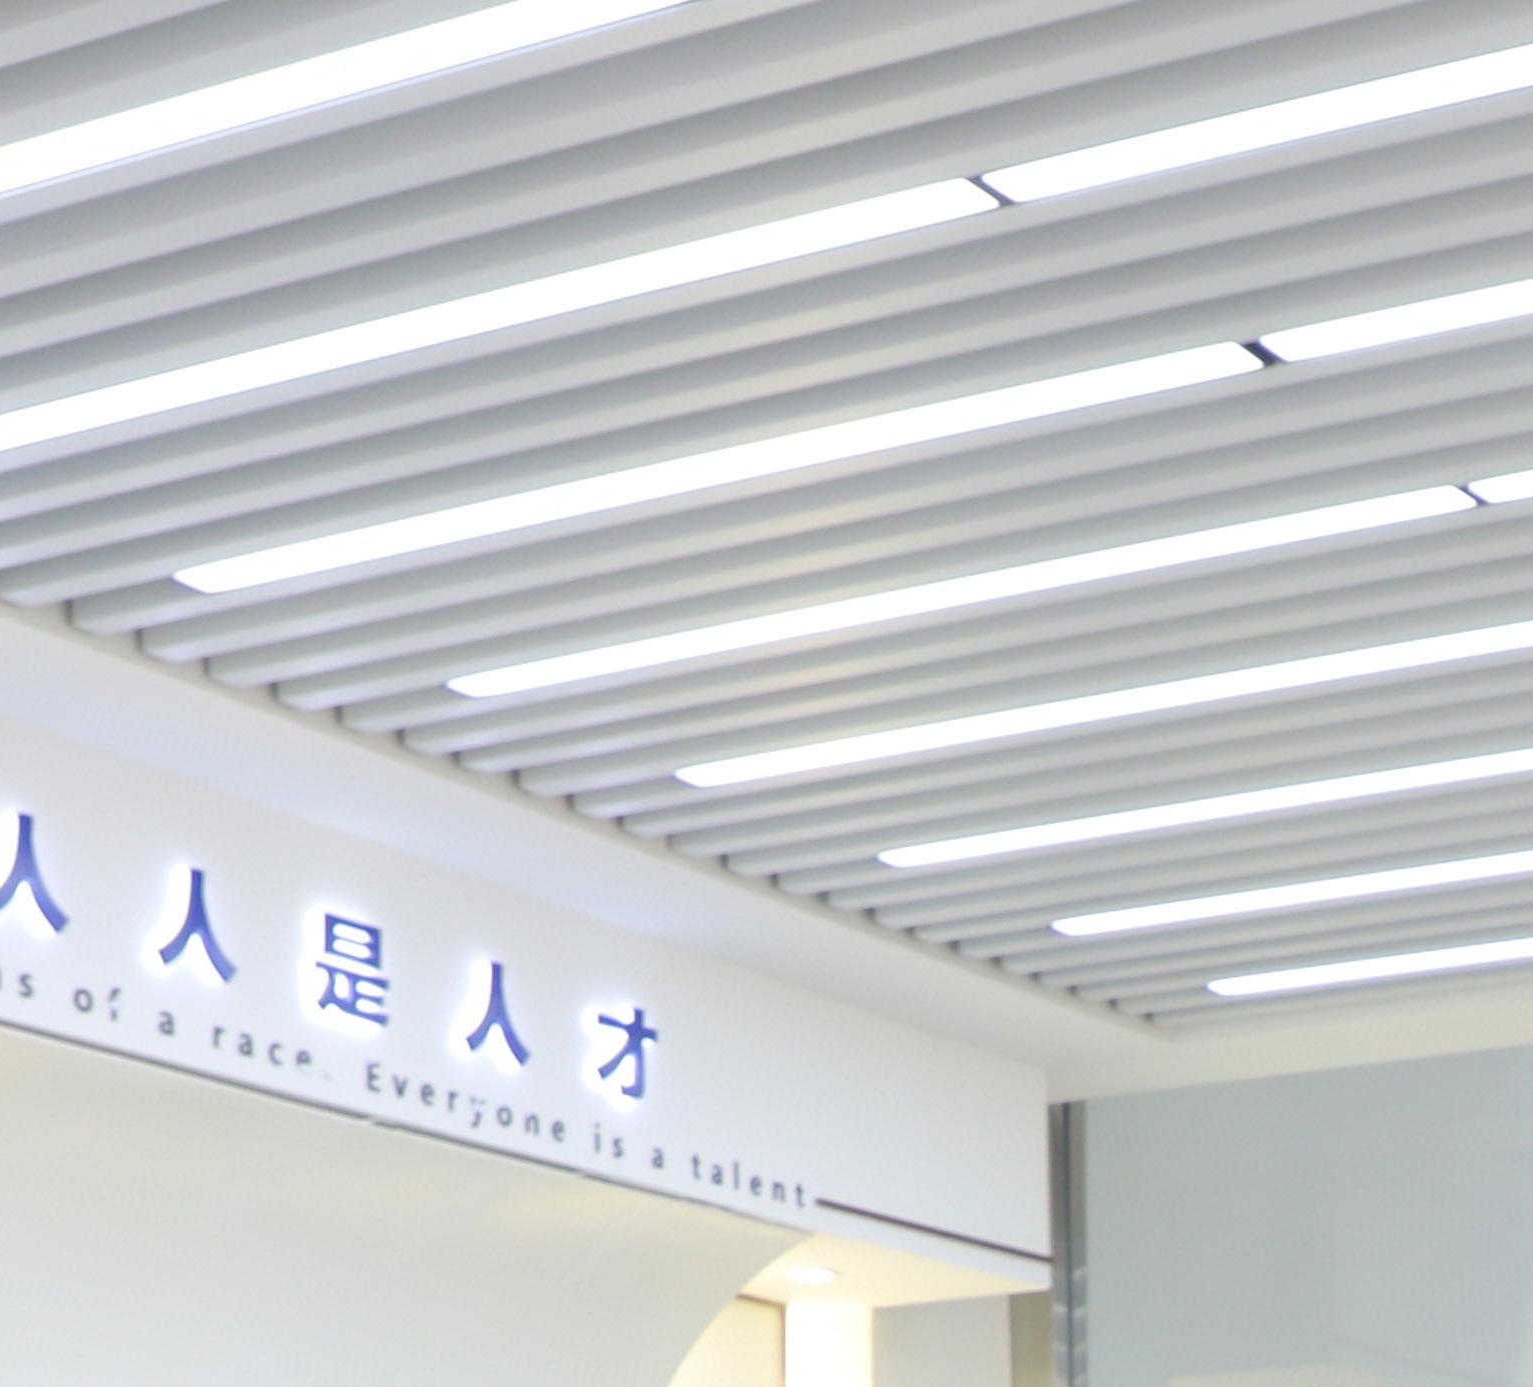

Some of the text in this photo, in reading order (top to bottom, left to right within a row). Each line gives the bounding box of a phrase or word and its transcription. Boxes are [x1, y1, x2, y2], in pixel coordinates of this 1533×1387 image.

[73, 988, 122, 1022] of
[158, 1011, 176, 1036] a
[366, 1062, 566, 1143] Everyone
[593, 1122, 625, 1159] is
[651, 1146, 665, 1170] a
[690, 1153, 806, 1208] talent
